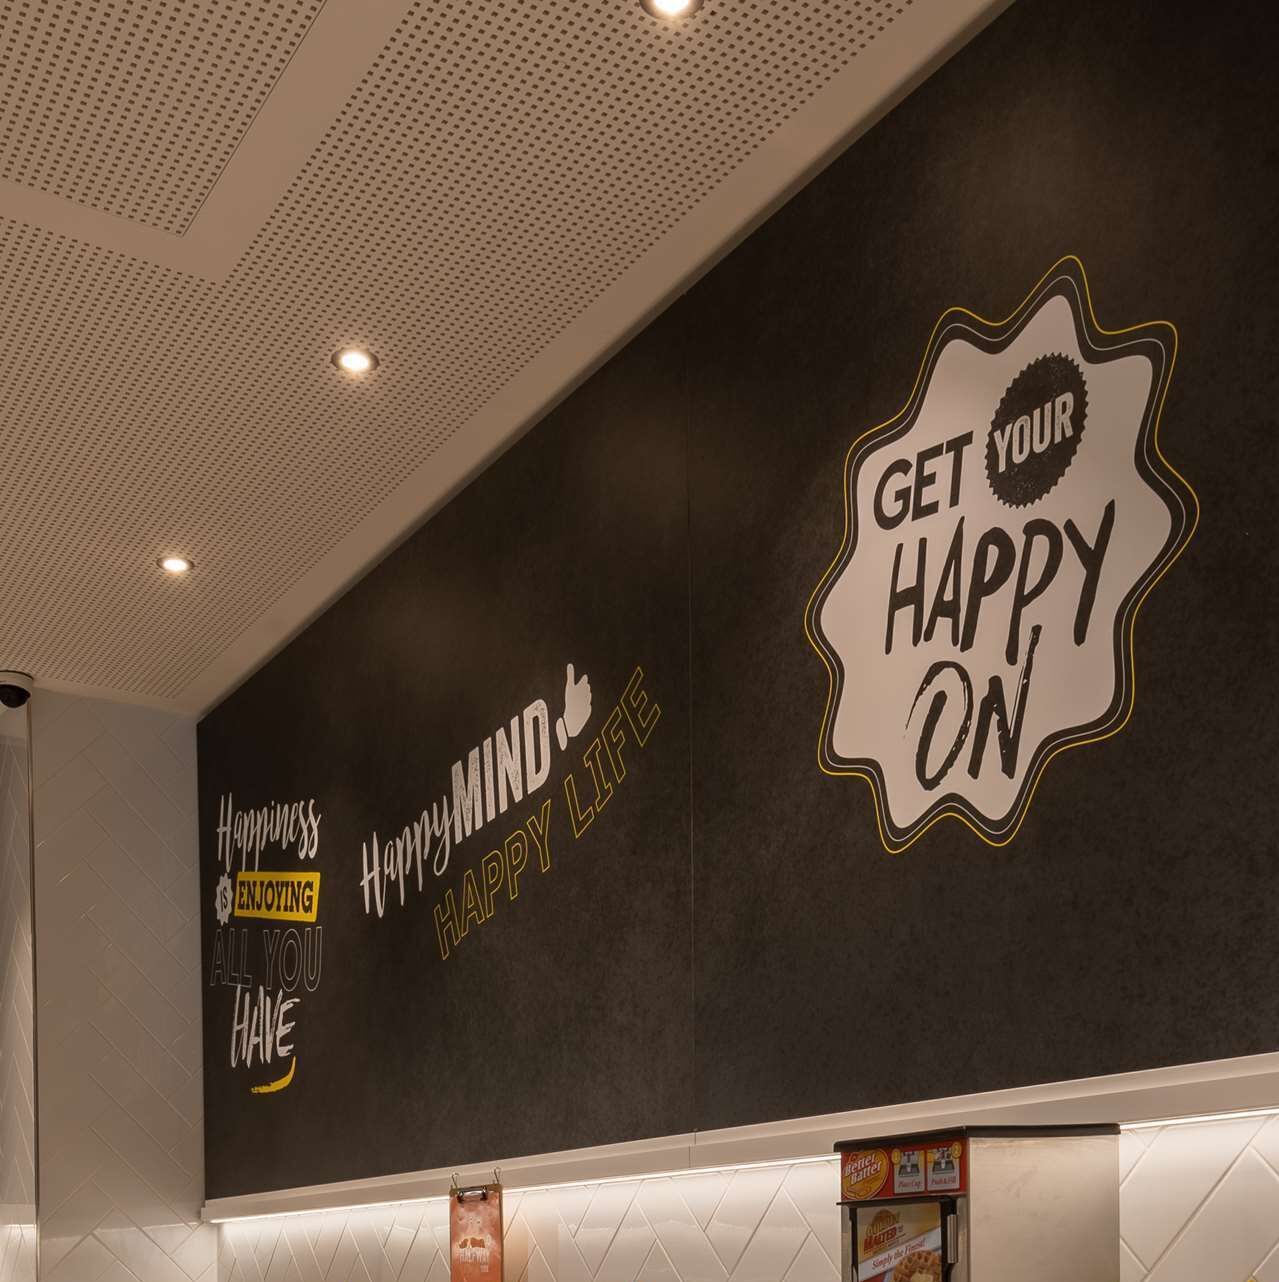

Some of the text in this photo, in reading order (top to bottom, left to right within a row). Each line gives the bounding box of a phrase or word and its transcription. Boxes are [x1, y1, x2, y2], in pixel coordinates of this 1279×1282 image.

[873, 392, 1074, 531] GET YOUR
[885, 499, 1116, 666] HAPPY
[451, 699, 552, 844] MIND
[904, 625, 1042, 791] ON
[217, 792, 322, 873] Happiness
[433, 666, 662, 961] HAPPY LIFE
[209, 926, 323, 992] ALL YOU
[237, 879, 315, 915] ENJOYING
[230, 984, 302, 1070] HAVE
